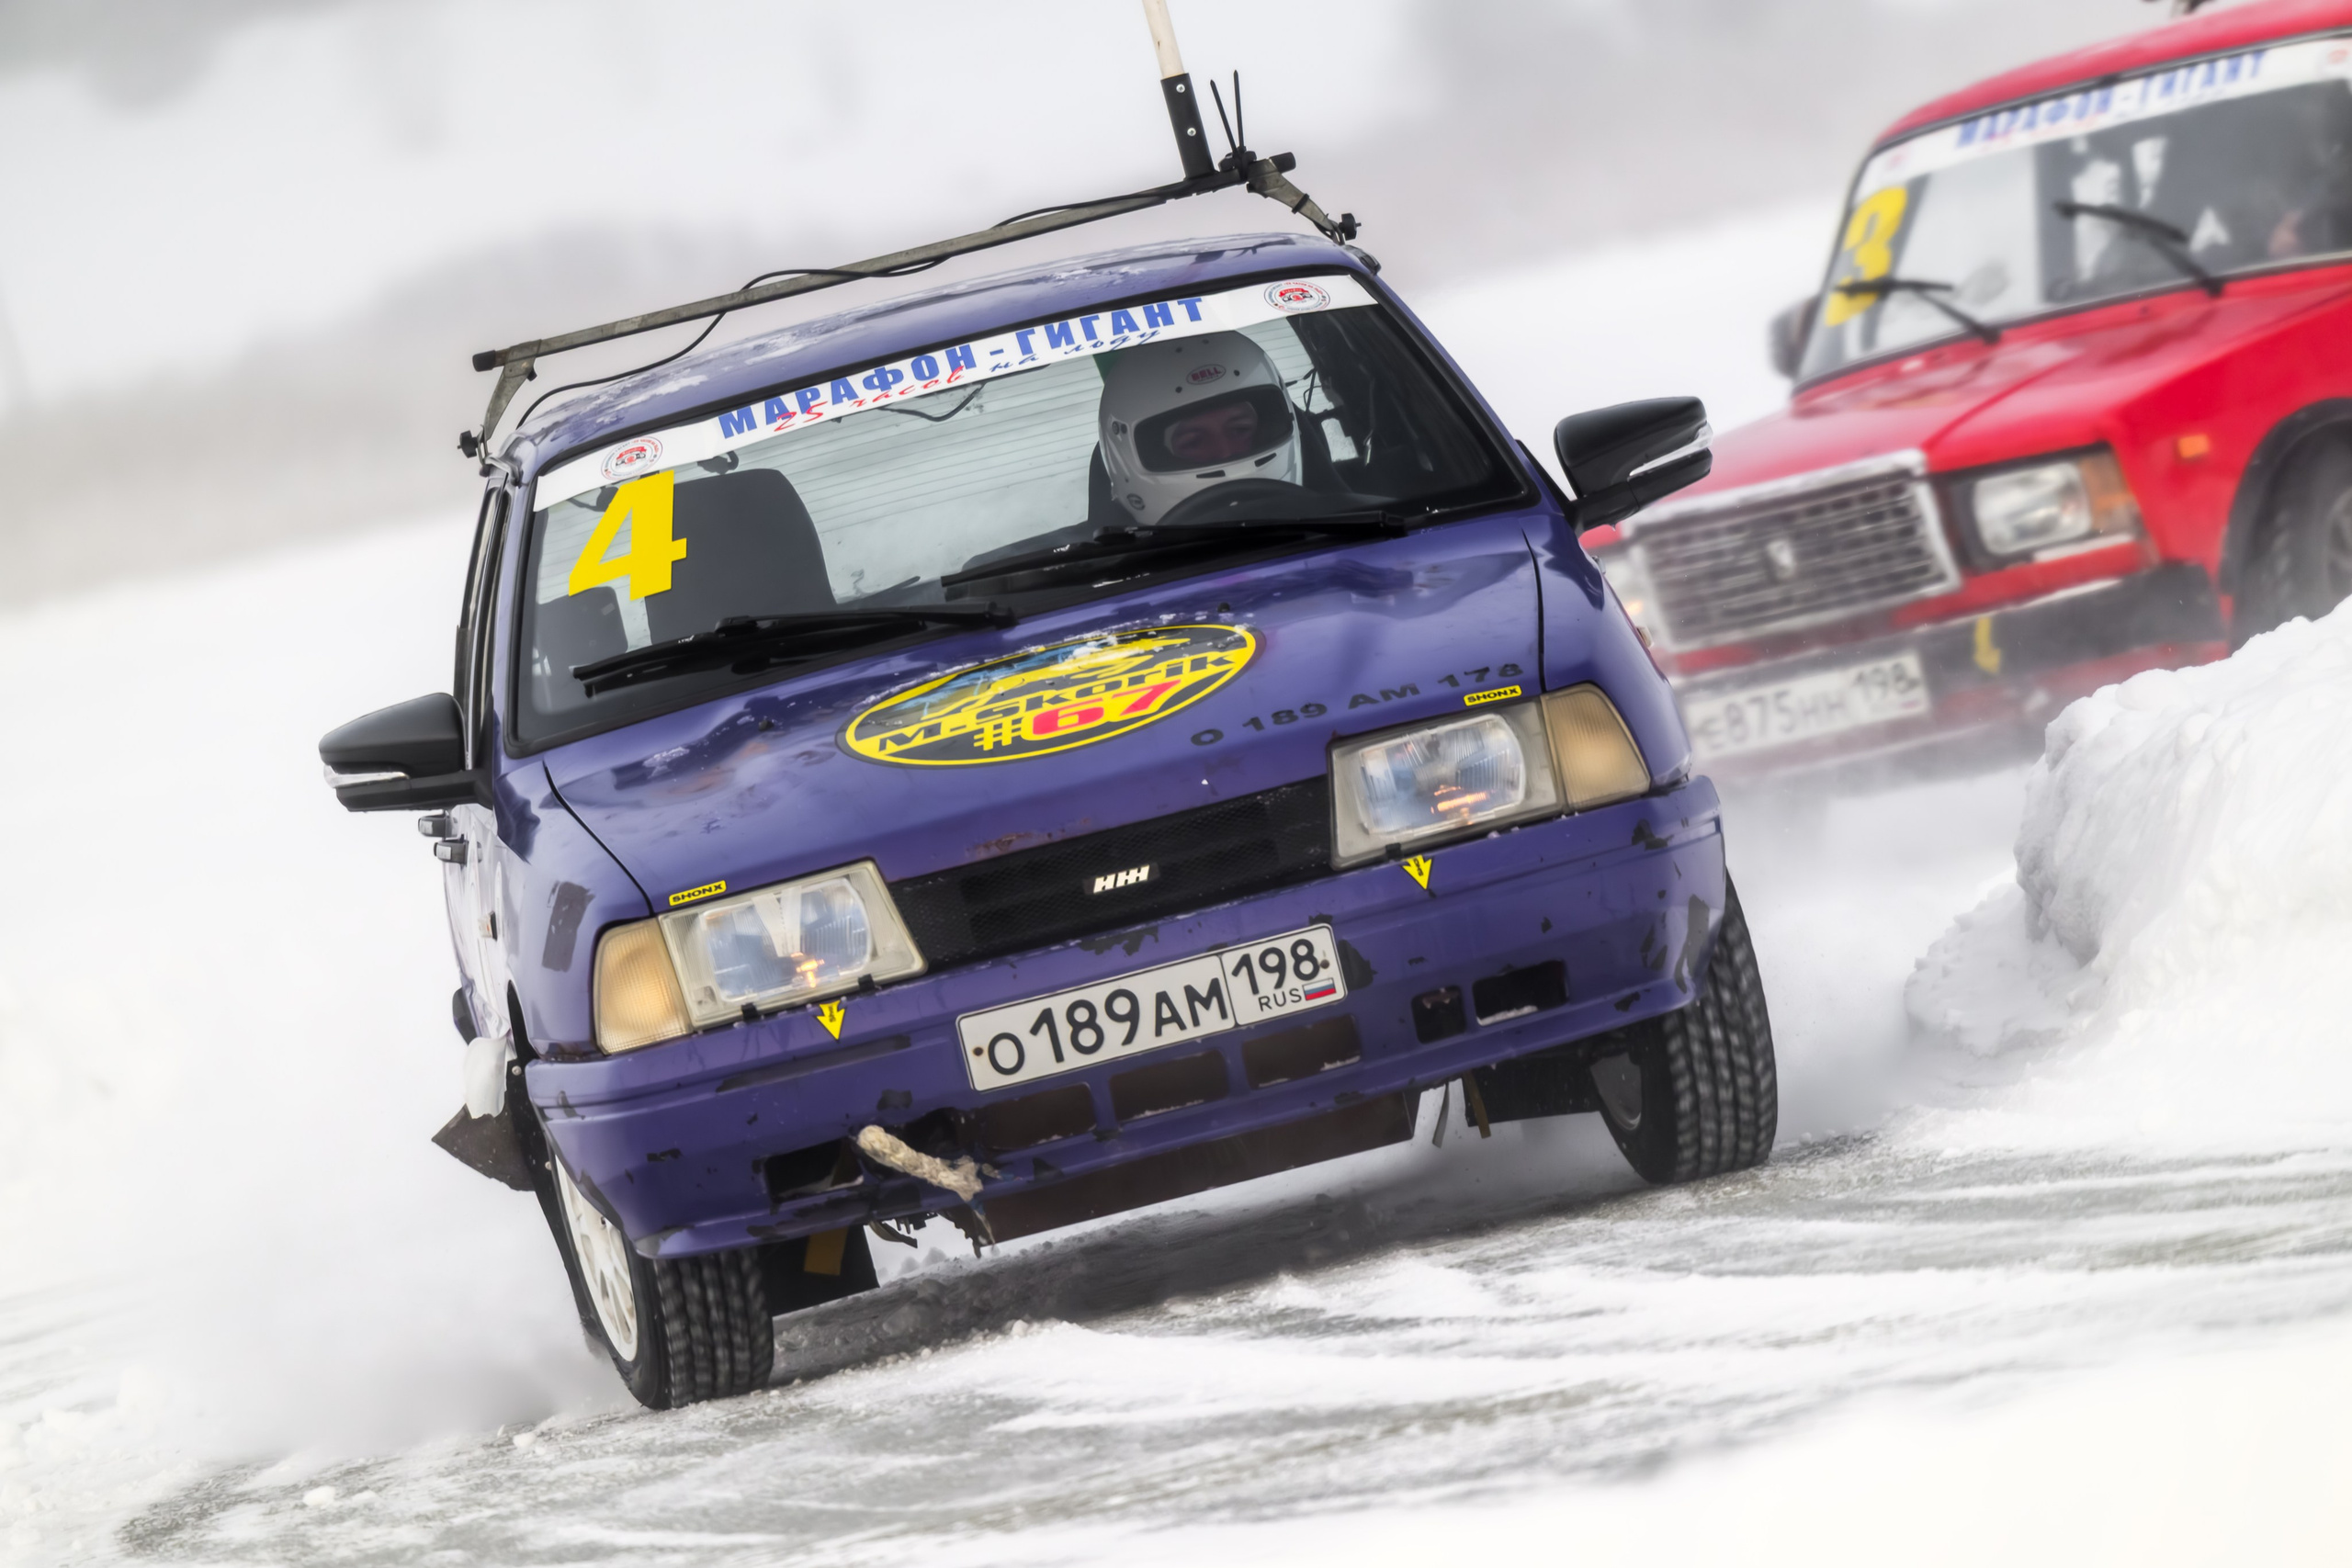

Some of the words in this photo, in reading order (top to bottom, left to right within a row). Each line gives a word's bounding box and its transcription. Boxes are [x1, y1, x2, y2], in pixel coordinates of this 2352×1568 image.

[774, 400, 829, 432] 25
[989, 353, 1040, 373] на
[569, 469, 687, 601] 4
[973, 678, 1182, 751] #67
[1190, 728, 1225, 747] О
[1242, 703, 1328, 732] 189
[1348, 682, 1420, 709] АМ
[1437, 663, 1524, 688] 178
[1467, 687, 1519, 704] SHONX
[672, 883, 724, 902] SHONX
[1231, 938, 1320, 995] 198
[1258, 987, 1303, 1012] RUS
